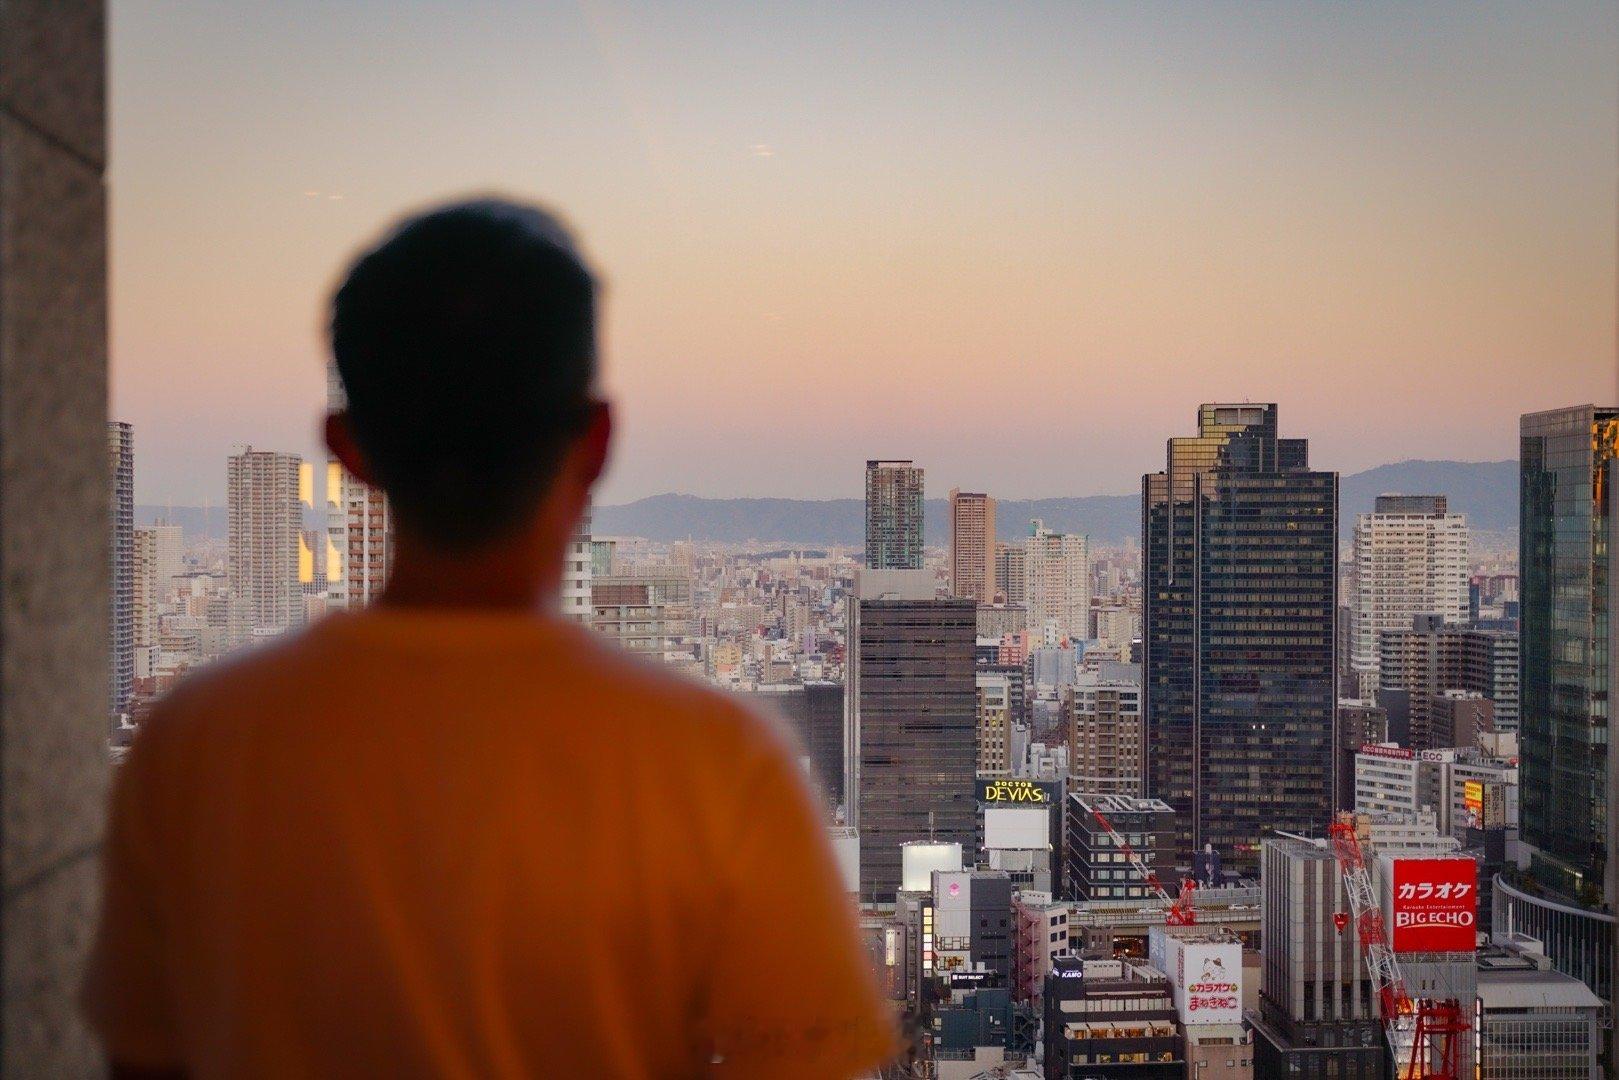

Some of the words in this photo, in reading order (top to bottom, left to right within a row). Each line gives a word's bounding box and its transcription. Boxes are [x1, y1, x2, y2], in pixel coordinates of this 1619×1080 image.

[1422, 752, 1443, 761] ECC
[985, 786, 1043, 802] DEVIAS
[1398, 882, 1472, 899] カラオケ
[1396, 911, 1427, 927] BIG
[1429, 911, 1473, 926] ECHO
[1196, 983, 1231, 993] カラオケ
[1189, 995, 1238, 1011] まねきねこ
